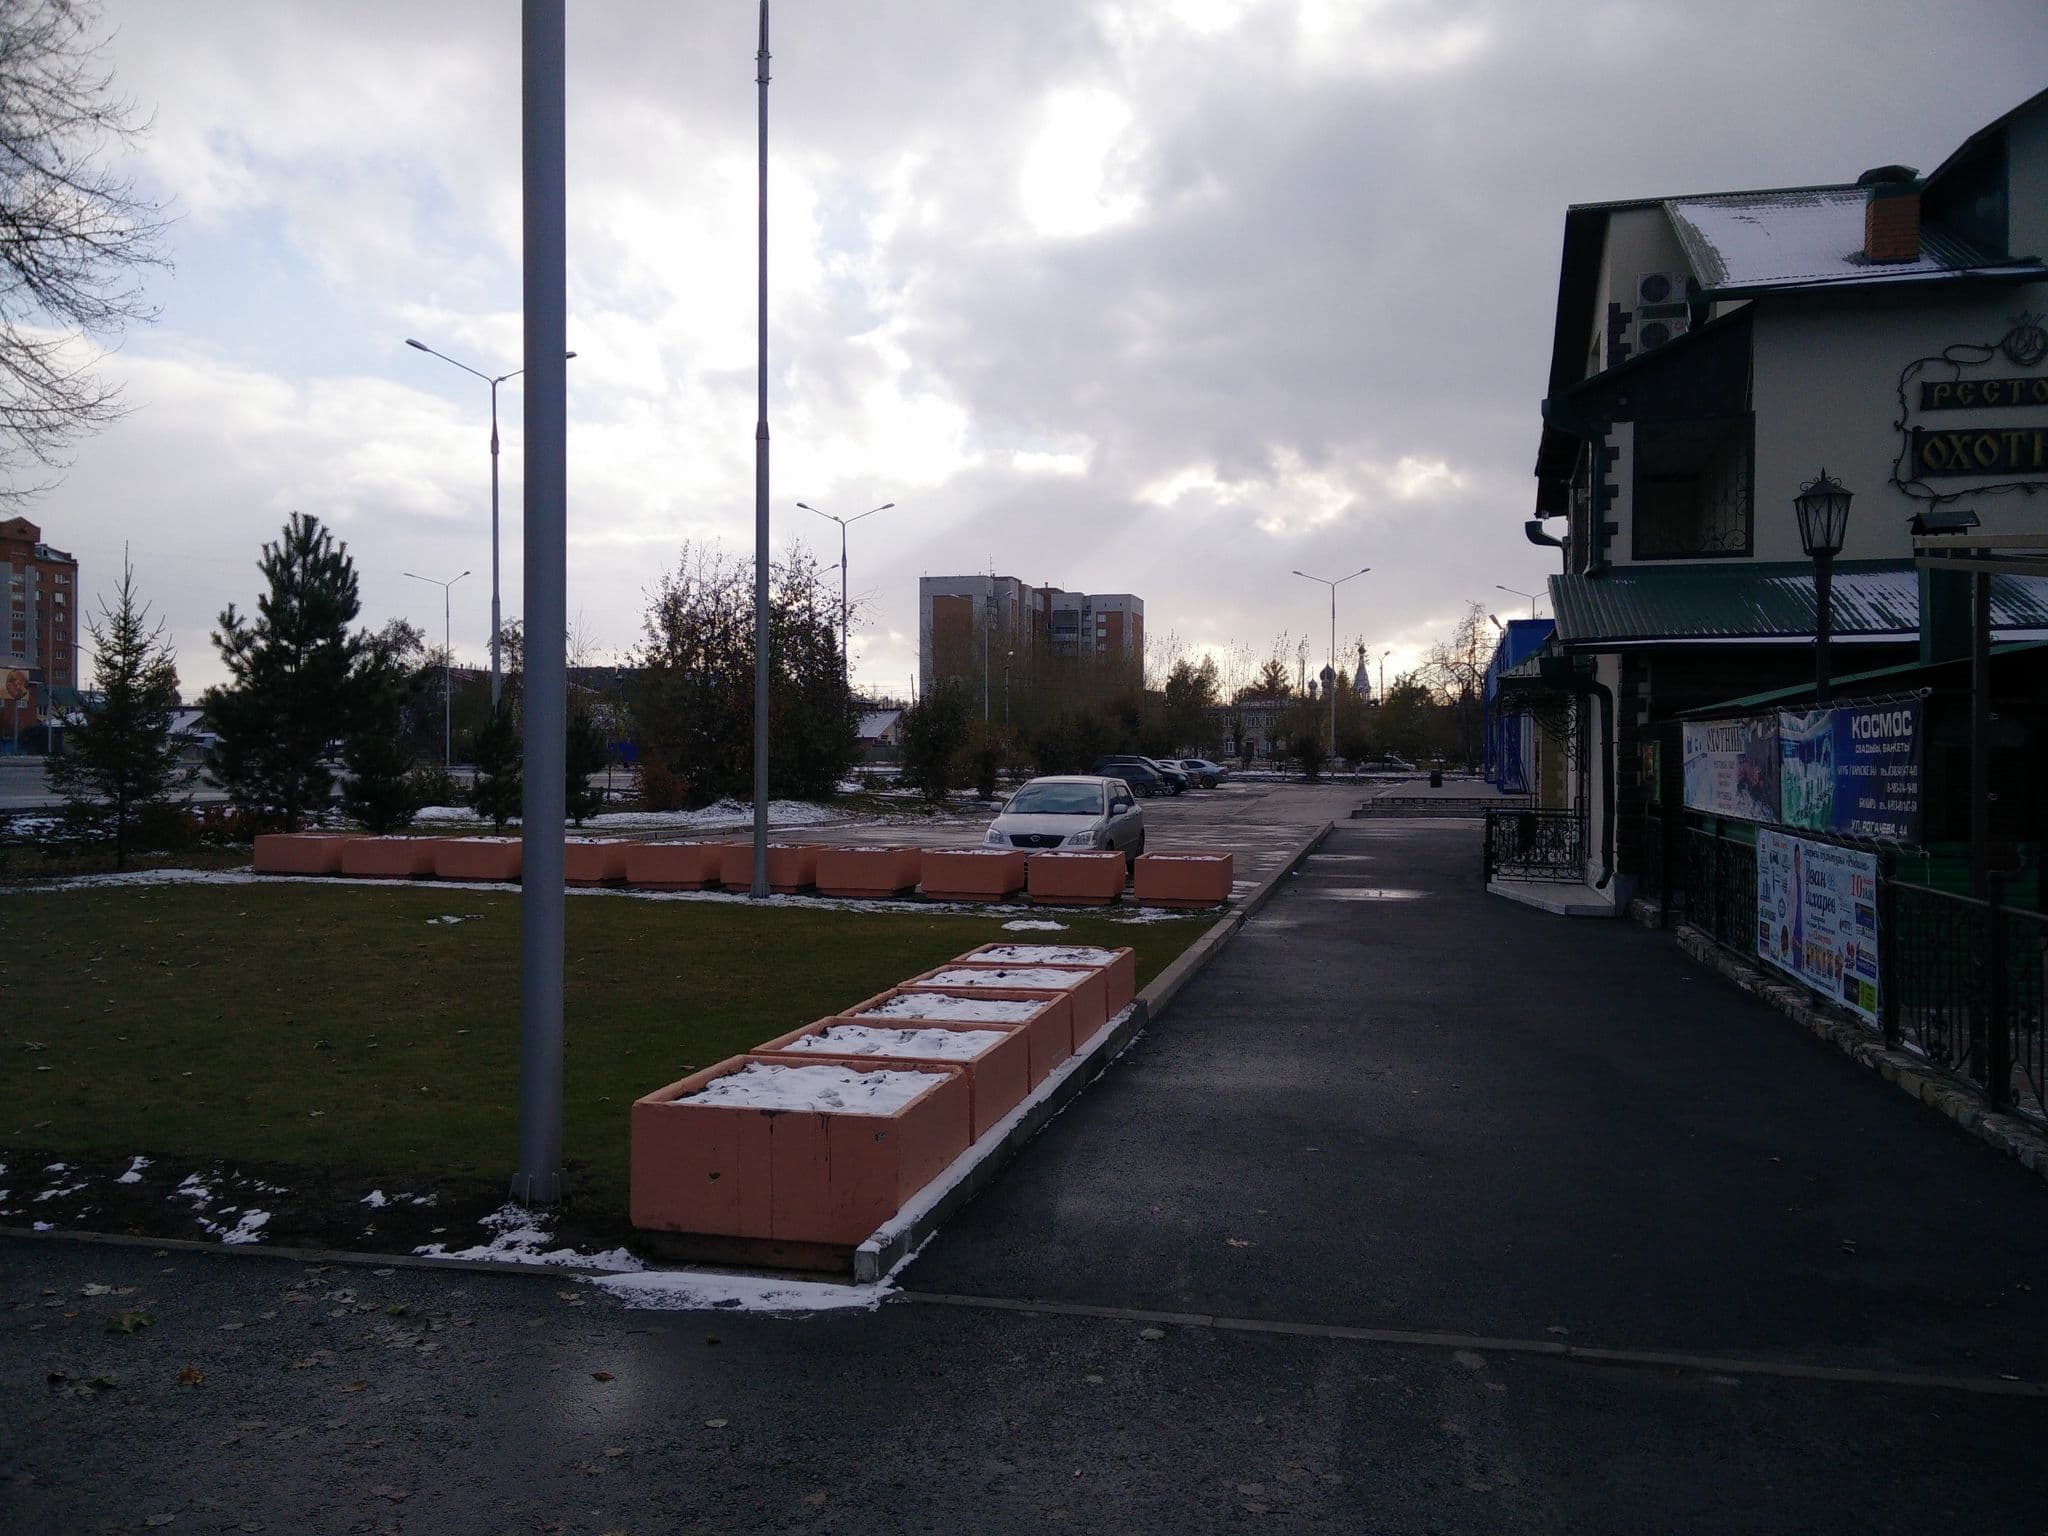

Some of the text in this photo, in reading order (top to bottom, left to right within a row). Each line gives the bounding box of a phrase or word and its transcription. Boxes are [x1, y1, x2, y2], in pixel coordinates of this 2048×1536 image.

[1934, 379, 2048, 407] РЕСТО
[1852, 710, 1913, 739] КОСМОС
[1706, 727, 1744, 752] ОХОТНИК
[1851, 874, 1863, 898] 10
